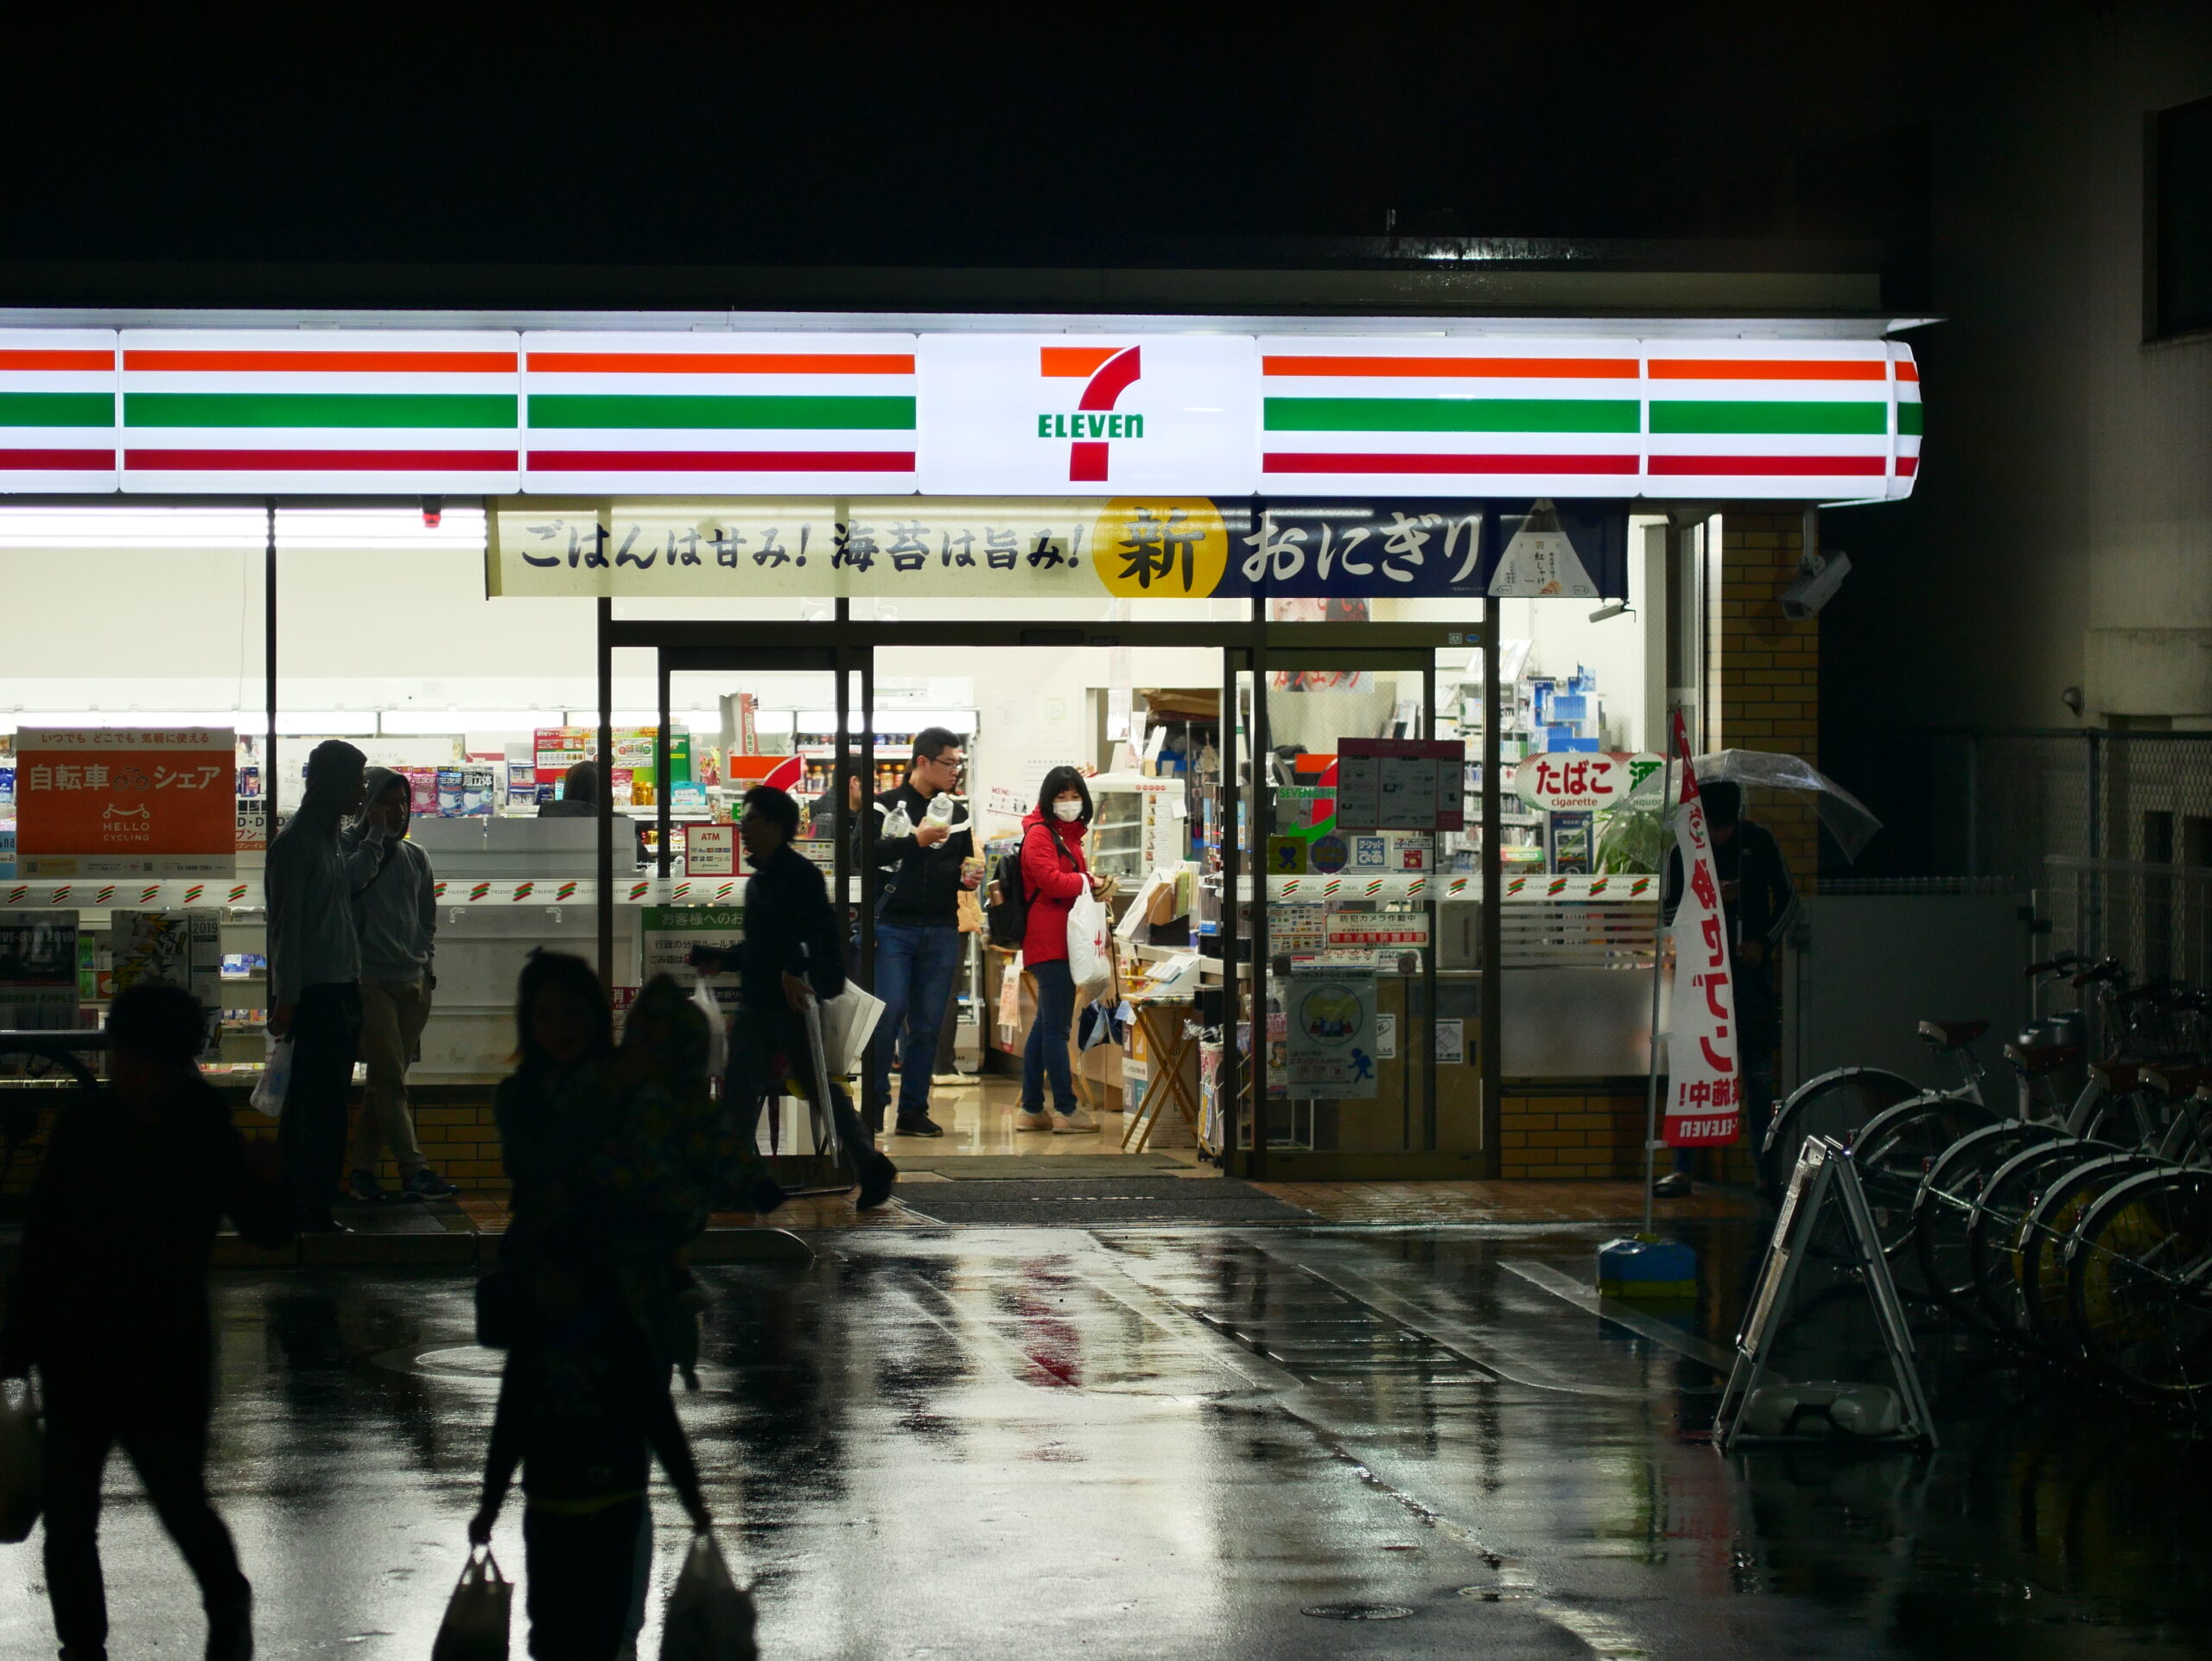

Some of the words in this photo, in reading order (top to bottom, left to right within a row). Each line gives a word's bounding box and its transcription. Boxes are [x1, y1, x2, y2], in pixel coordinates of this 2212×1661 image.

[1117, 505, 1207, 593] 新
[1241, 510, 1481, 584] おにぎり
[41, 733, 85, 744] いつでも
[92, 733, 135, 744] どこでも
[142, 733, 209, 744] 気軽に使える
[29, 764, 110, 791] 自転車
[154, 766, 221, 790] シェア
[463, 774, 493, 786] 超立体
[1536, 760, 1613, 795] たばこ
[1551, 798, 1598, 808] cigarette
[103, 822, 149, 832] HELLO
[701, 832, 720, 842] ATM
[193, 922, 219, 934] 2019
